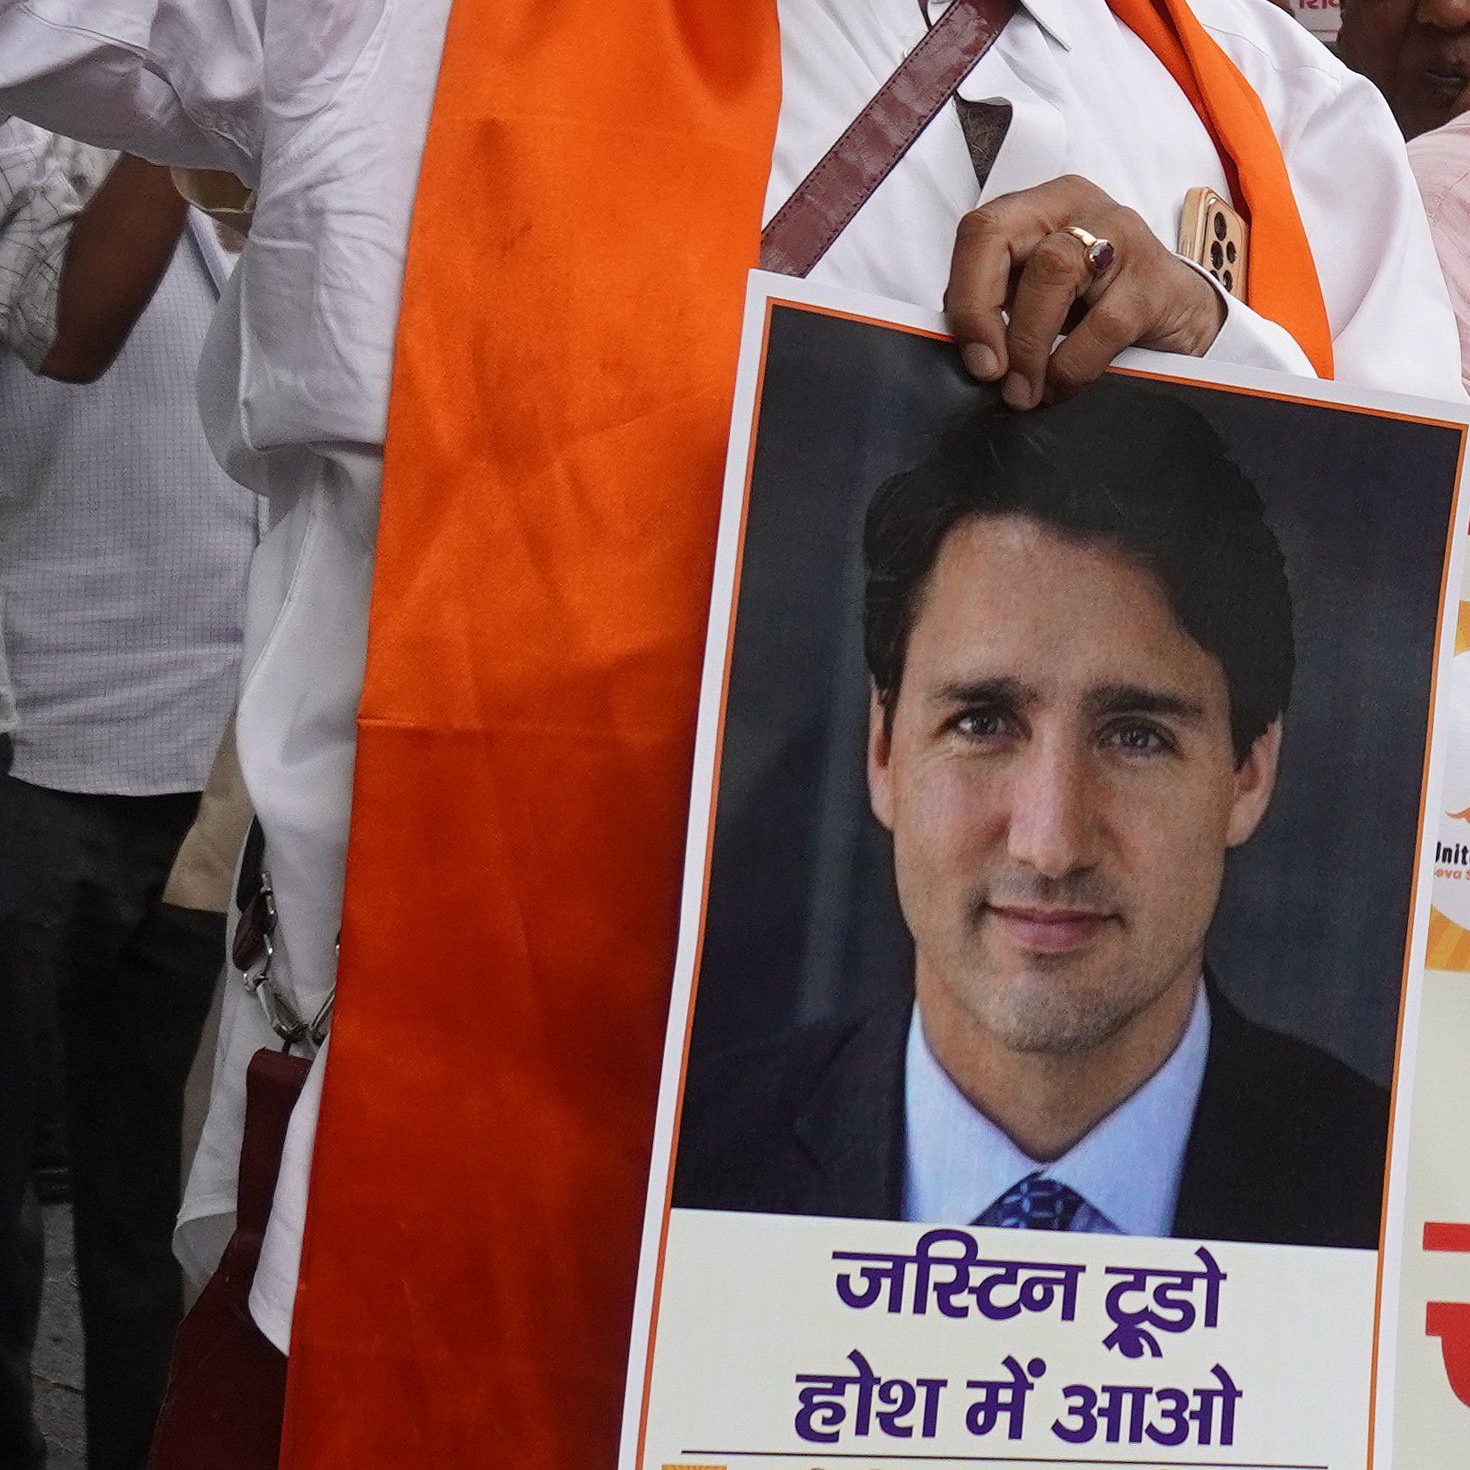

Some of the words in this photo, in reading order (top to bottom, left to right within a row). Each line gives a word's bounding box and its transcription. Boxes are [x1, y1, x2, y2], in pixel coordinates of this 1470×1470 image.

[1434, 867, 1463, 880] eva
[831, 1228, 1087, 1323] जस्टिन
[793, 1348, 949, 1444] होश
[964, 1354, 1048, 1442] में
[1050, 1362, 1244, 1447] आओ
